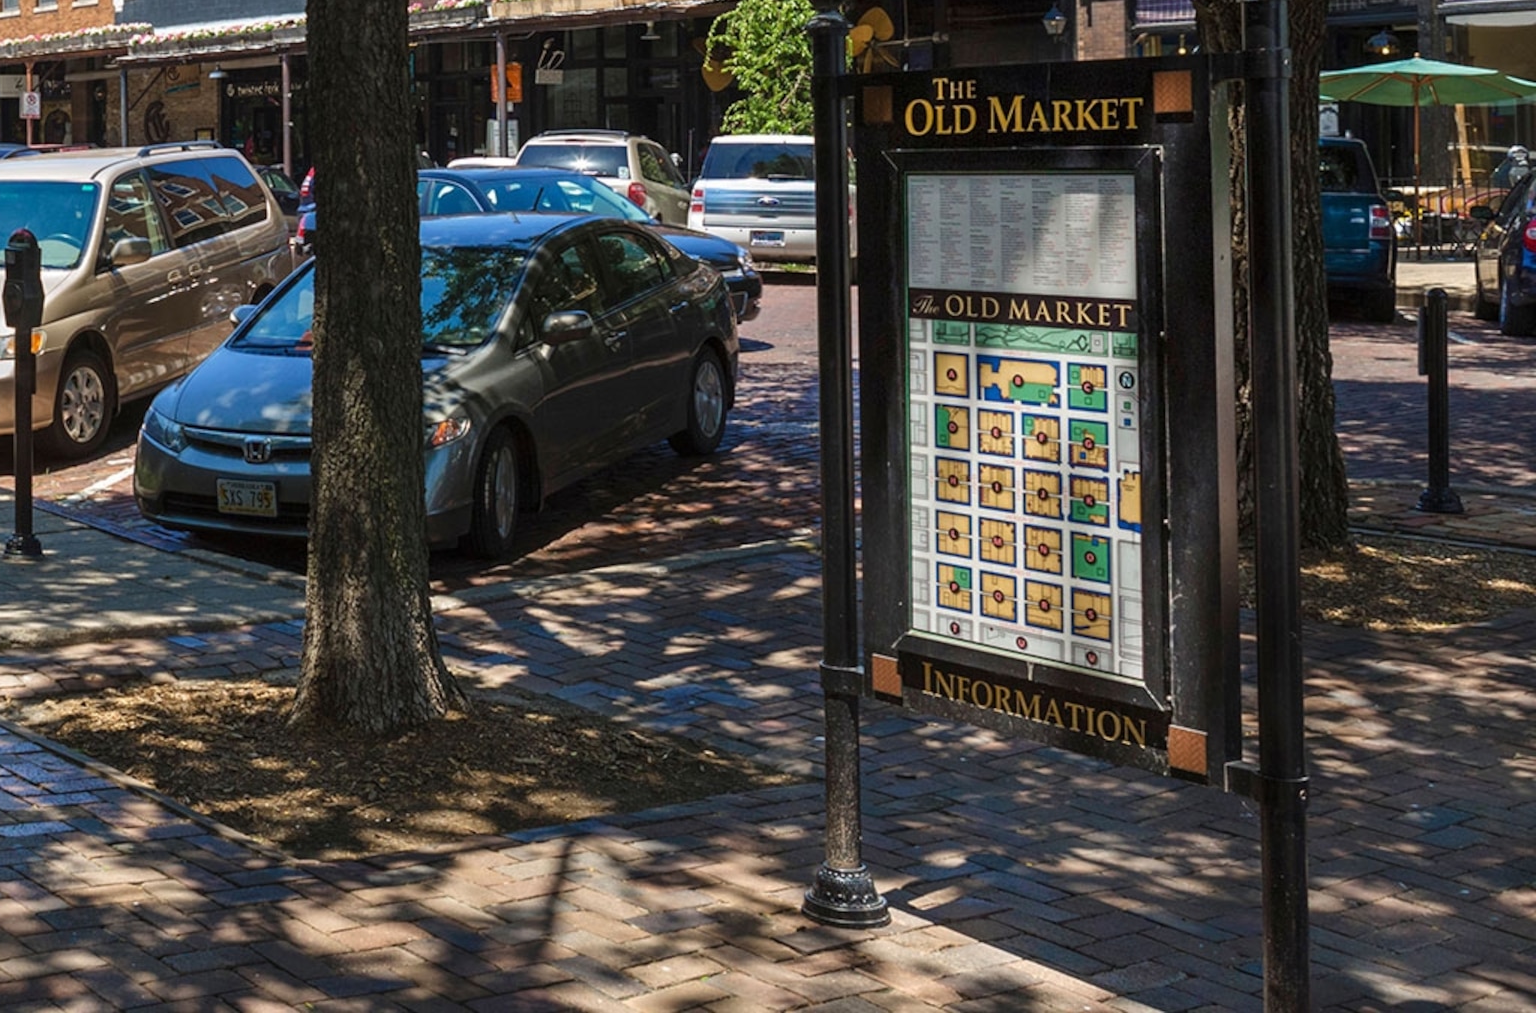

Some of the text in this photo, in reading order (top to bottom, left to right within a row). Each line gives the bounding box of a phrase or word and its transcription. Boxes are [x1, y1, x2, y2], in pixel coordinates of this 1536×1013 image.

[932, 77, 977, 101] THE
[904, 94, 1144, 137] OLD MARKET
[912, 294, 1132, 328] The OLD MARKET
[222, 489, 273, 508] SXS 795
[921, 662, 1146, 749] INFORMATION
